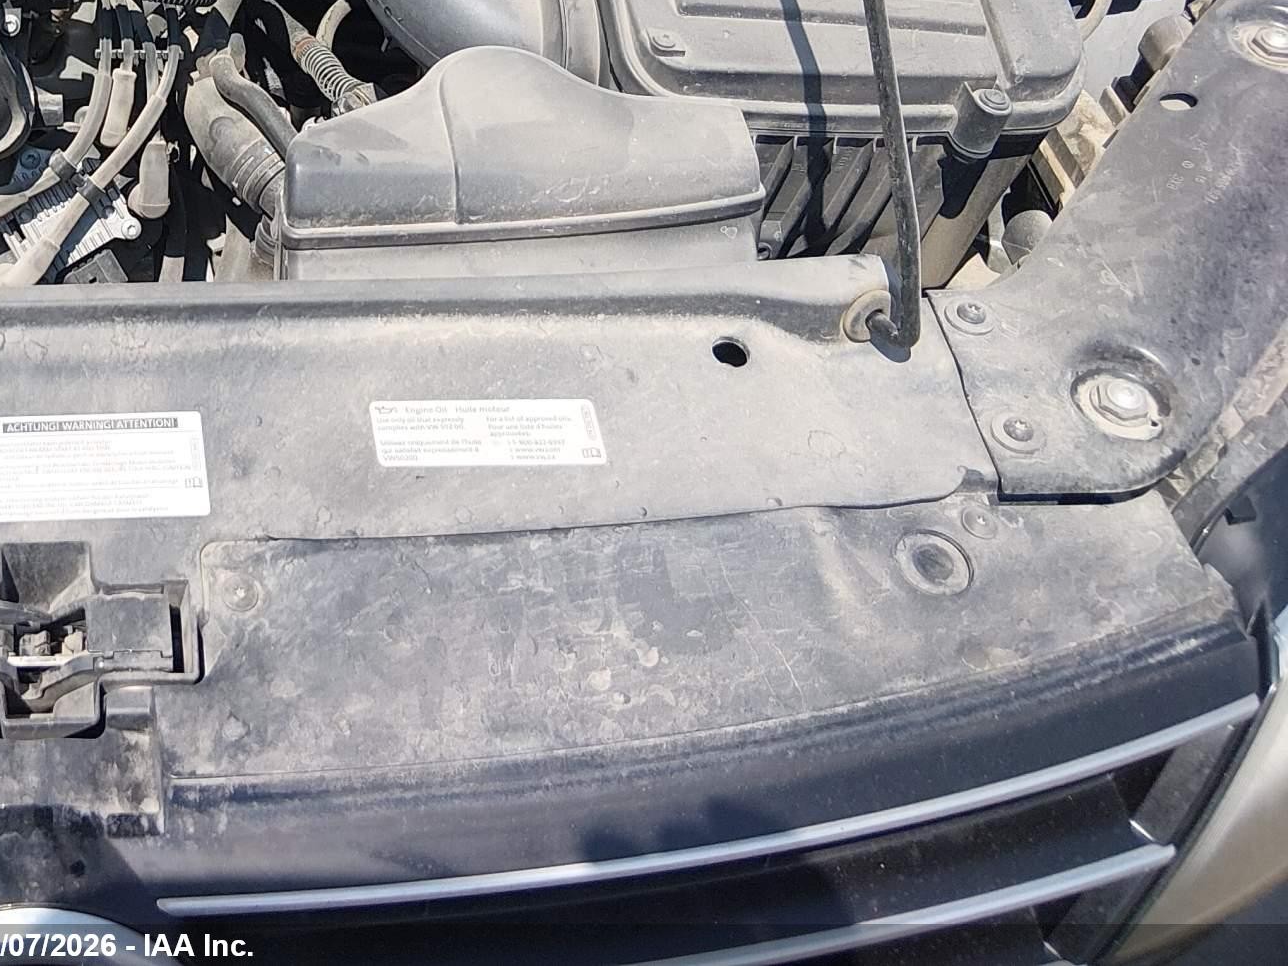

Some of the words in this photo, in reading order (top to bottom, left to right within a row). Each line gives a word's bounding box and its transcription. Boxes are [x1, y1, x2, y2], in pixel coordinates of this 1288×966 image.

[6, 421, 59, 433] ACHTUNG!
[61, 419, 114, 431] WARNING!
[116, 418, 176, 429] ATTENTION!
